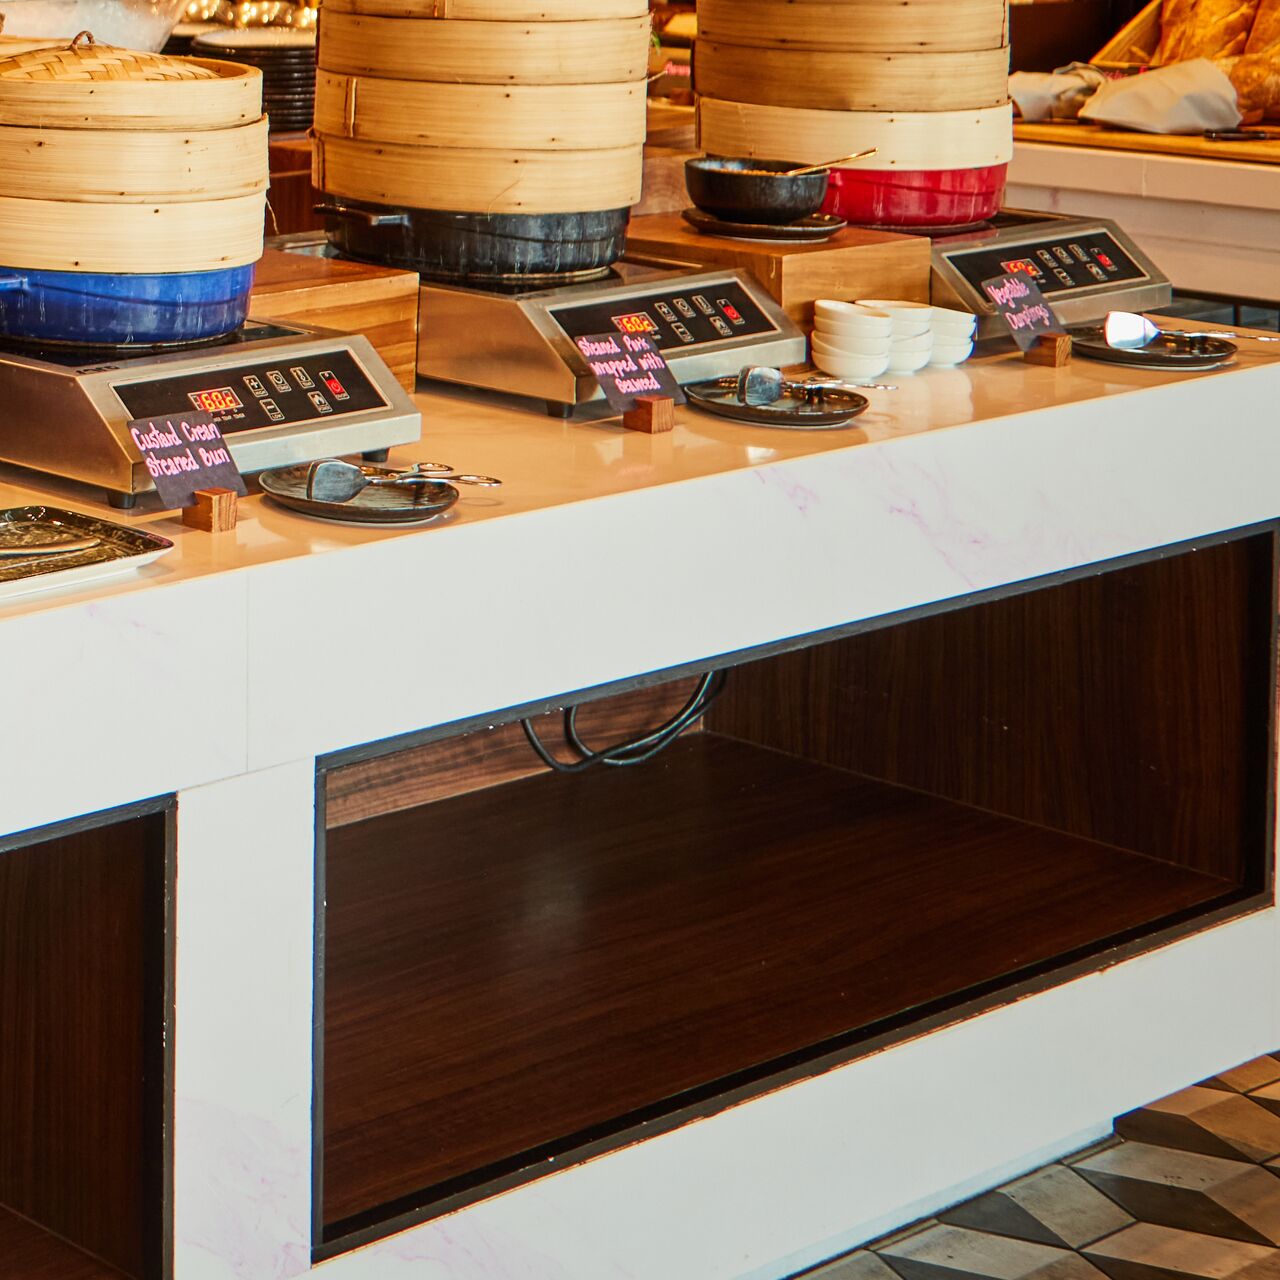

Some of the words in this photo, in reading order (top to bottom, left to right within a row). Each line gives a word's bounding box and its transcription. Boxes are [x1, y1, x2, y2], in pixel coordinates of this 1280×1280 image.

[623, 335, 650, 352] Pork
[638, 352, 665, 370] with
[130, 420, 182, 451] Custard
[199, 447, 230, 467] Bun
